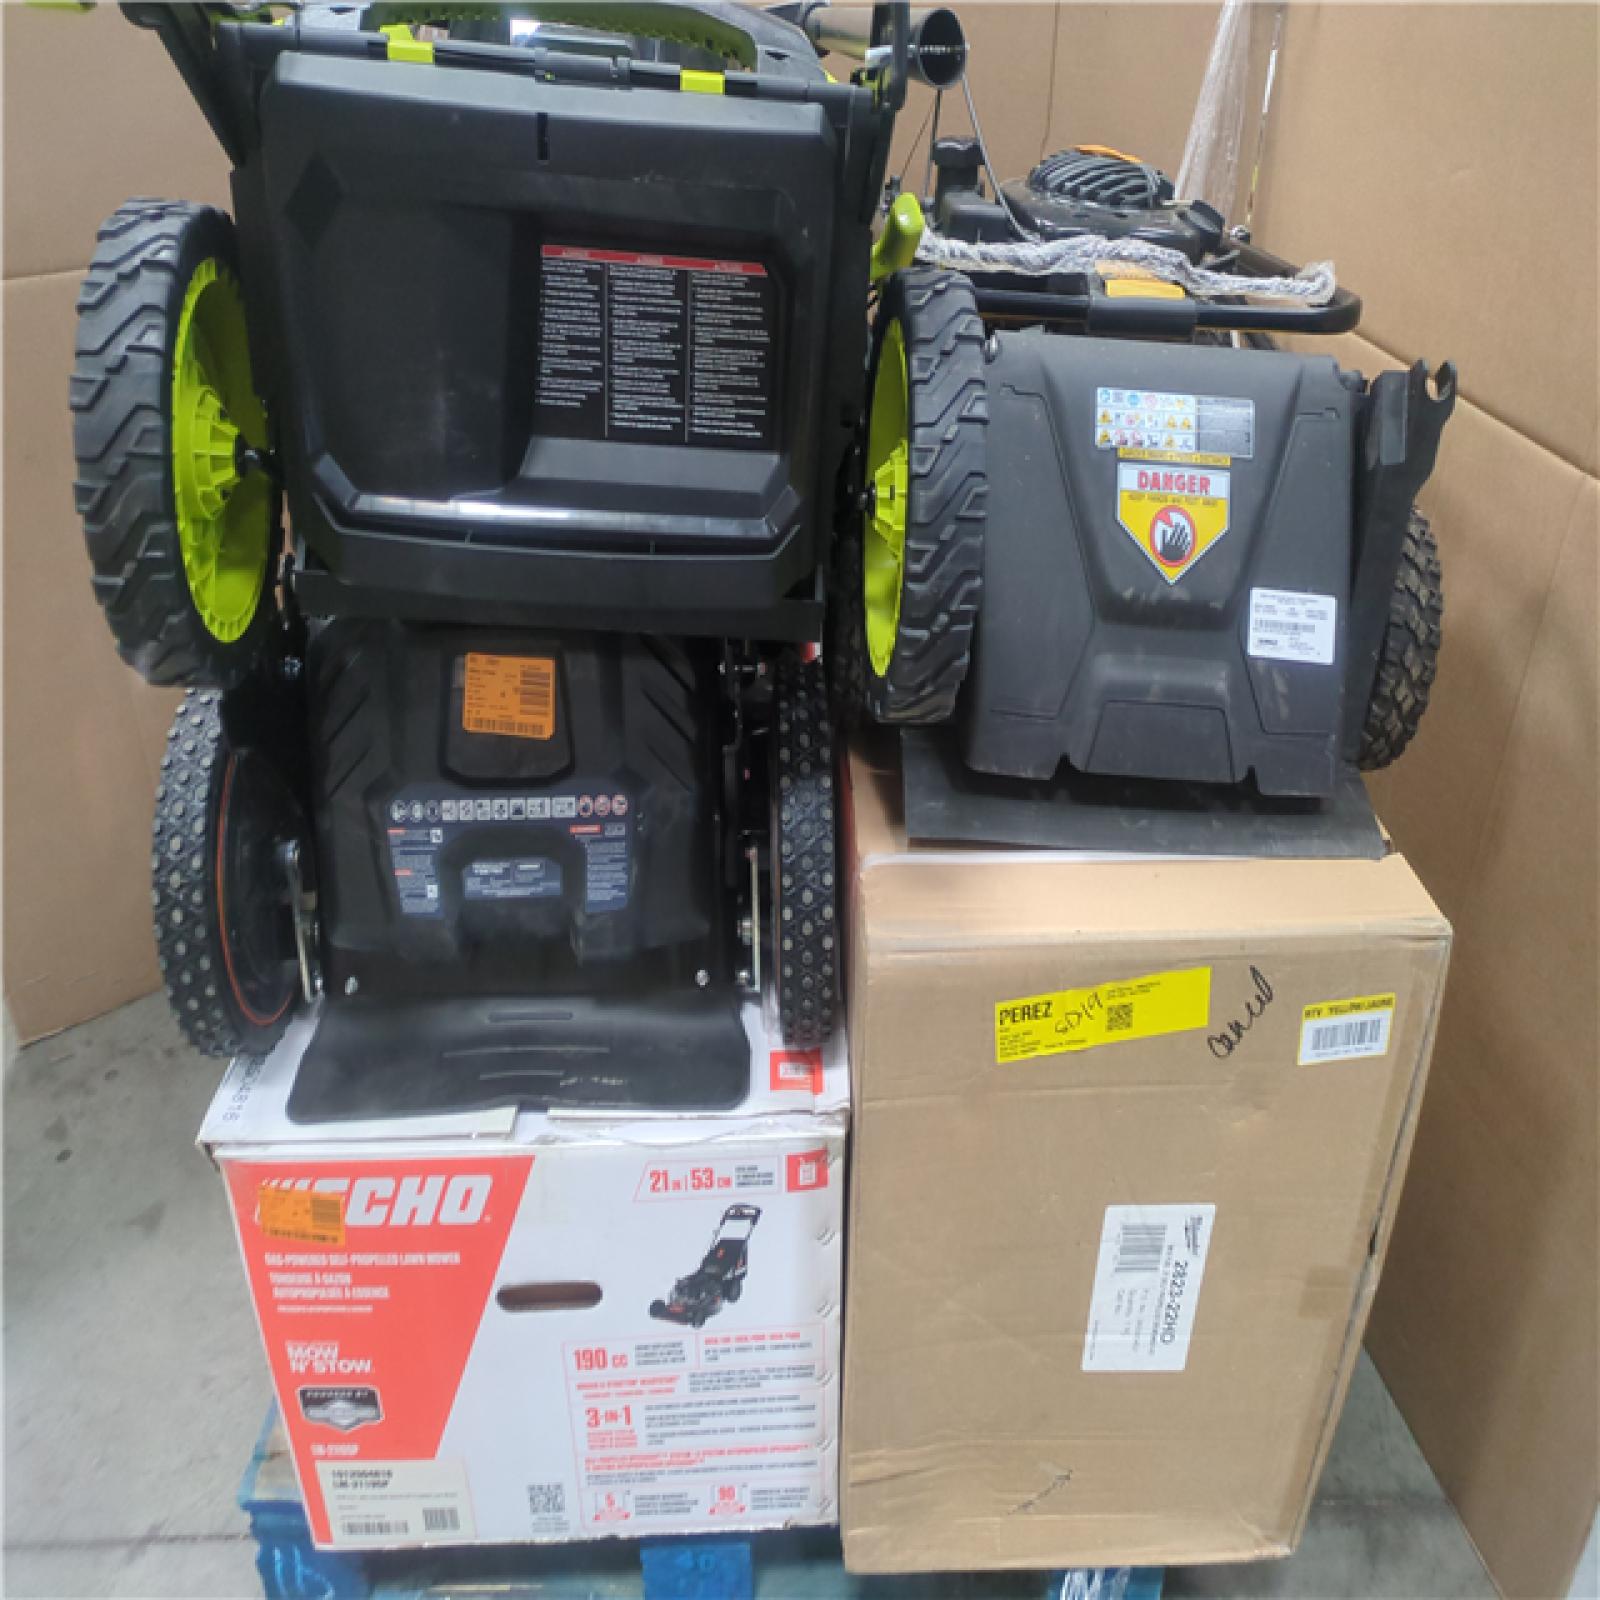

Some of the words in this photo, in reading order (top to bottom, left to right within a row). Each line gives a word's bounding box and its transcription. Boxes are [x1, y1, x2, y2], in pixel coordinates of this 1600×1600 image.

[1137, 470, 1211, 495] DANGER
[999, 1000, 1053, 1026] PEREZ
[649, 1170, 669, 1193] 21
[690, 1167, 715, 1190] 53
[312, 1175, 493, 1225] CHO
[286, 1342, 338, 1360] MOW
[574, 1348, 608, 1371] 190
